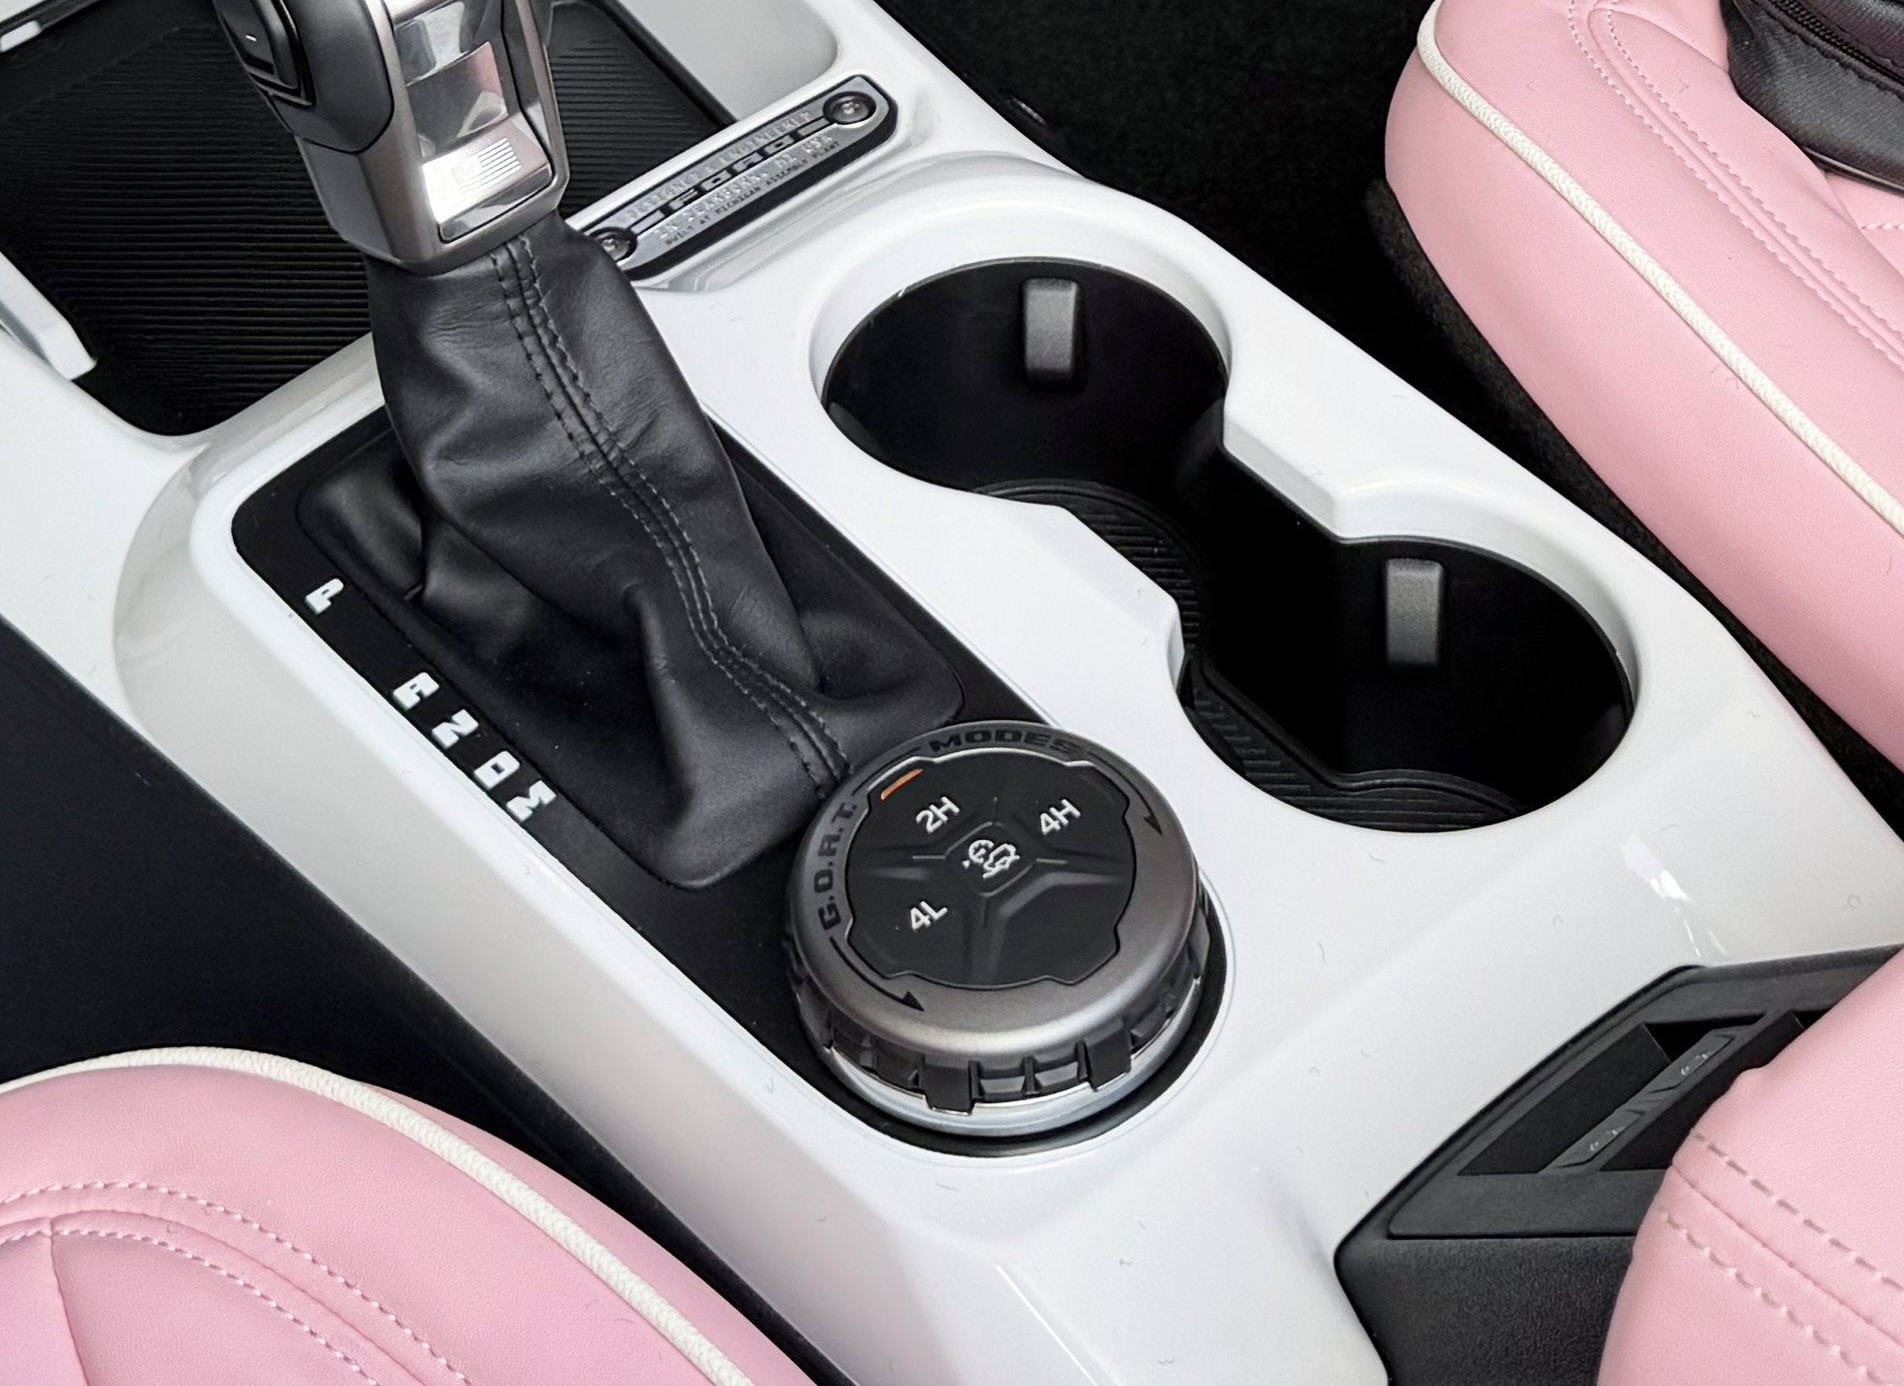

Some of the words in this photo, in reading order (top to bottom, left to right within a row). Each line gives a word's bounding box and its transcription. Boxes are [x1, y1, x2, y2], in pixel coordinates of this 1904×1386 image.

[304, 578, 345, 615] P
[392, 671, 440, 711] R
[432, 708, 479, 749] N
[929, 729, 1082, 755] MODES
[473, 750, 520, 791] D
[506, 779, 557, 822] M
[915, 796, 960, 834] 2H
[1039, 798, 1081, 836] 4H
[909, 901, 948, 932] 4L
